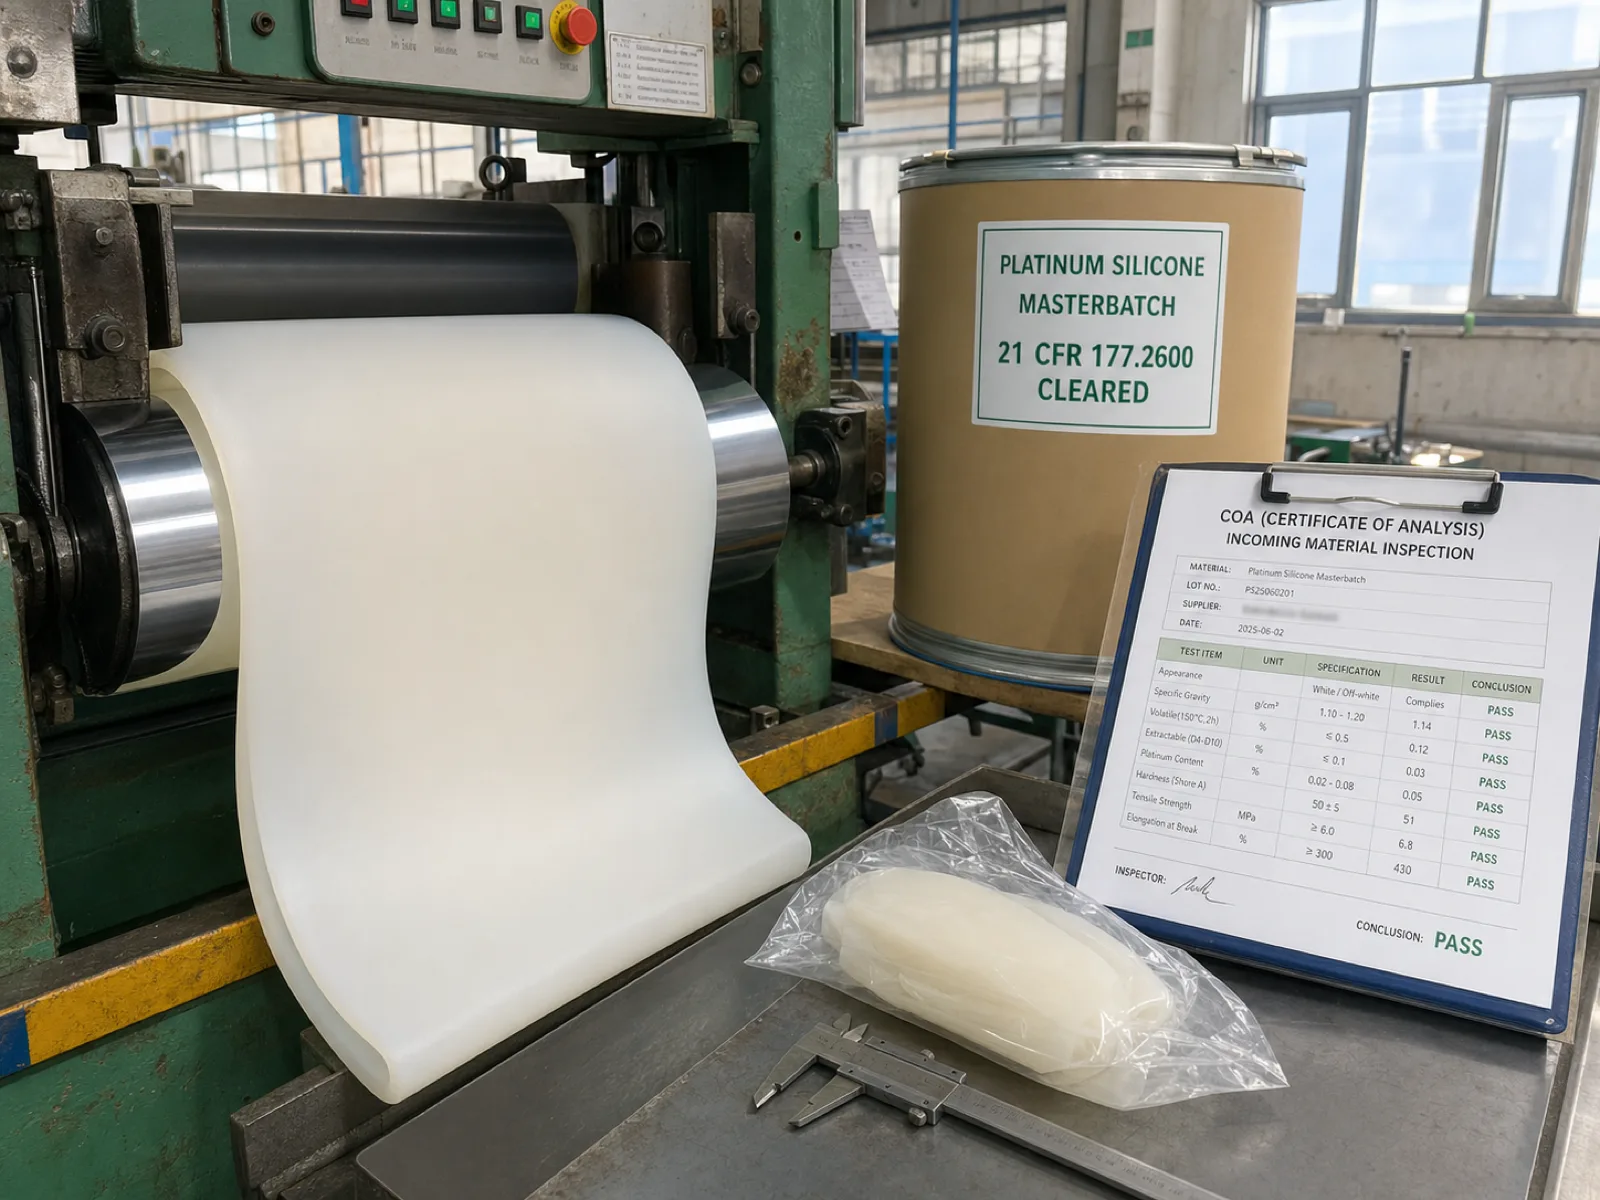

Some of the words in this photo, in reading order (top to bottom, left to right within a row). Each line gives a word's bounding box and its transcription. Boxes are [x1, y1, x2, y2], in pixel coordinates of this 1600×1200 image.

[1000, 254, 1104, 275] PLATINUM
[1112, 255, 1204, 276] SILICONE
[1019, 294, 1175, 316] MASTERBATCH
[999, 341, 1021, 364] 21
[1035, 342, 1082, 366] CFR
[1092, 344, 1193, 368] 177.2600
[1038, 378, 1149, 403] CLEARED
[1220, 509, 1254, 525] COA
[1261, 510, 1368, 532] (CERTIFICATE
[1372, 517, 1394, 532] OF
[1398, 518, 1485, 540] ANALYSIS)
[1226, 532, 1301, 550] INCOMING
[1305, 537, 1377, 555] MATERIAL
[1383, 541, 1474, 561] INSPECTION
[1190, 562, 1231, 574] MATERIAL:
[1248, 567, 1282, 578] Platinum
[1283, 569, 1314, 580] Silicone
[1316, 571, 1366, 584] Masterbatch
[1187, 581, 1202, 592] LOT
[1204, 582, 1221, 593] NO.:
[1183, 599, 1221, 612] SUPPLIER:
[1180, 618, 1202, 629] DATE:
[1238, 624, 1284, 637] 2025-06-02
[1181, 647, 1200, 657] TEST
[1202, 649, 1222, 659] ITEM
[1263, 656, 1284, 666] UNIT
[1159, 667, 1202, 680] Appearance
[1318, 663, 1380, 677] SPECIFICATION
[1412, 674, 1445, 684] RESULT
[1313, 685, 1336, 695] White
[1342, 688, 1379, 701] Off-white
[1472, 680, 1531, 694] CONCLUSION
[1154, 687, 1182, 699] Specific
[1184, 691, 1210, 704] Gravity
[1406, 696, 1444, 709] Complies
[1320, 708, 1337, 719] 1.10
[1347, 712, 1365, 722] 1.20
[1488, 705, 1514, 717] PASS
[1259, 723, 1267, 731] %
[1413, 720, 1431, 730] 1.14
[1146, 728, 1186, 742] Extractable
[1336, 733, 1349, 743] 0.5
[1485, 729, 1511, 741] PASS
[1255, 745, 1263, 753] %
[1409, 744, 1428, 754] 0.12
[1141, 749, 1172, 761] Platinum
[1174, 754, 1204, 767] Content
[1333, 756, 1345, 765] 0.1
[1482, 753, 1508, 765] PASS
[1252, 767, 1259, 776] %
[1406, 767, 1425, 778] 0.03
[1172, 775, 1196, 788] (Shore
[1198, 780, 1206, 790] A)
[1308, 776, 1326, 787] 0.02
[1335, 779, 1354, 790] 0.08
[1479, 777, 1506, 790] PASS
[1402, 790, 1422, 801] 0.05
[1159, 797, 1192, 810] Strength
[1312, 800, 1324, 809] 50
[1333, 803, 1339, 812] 5
[1476, 801, 1503, 814] PASS
[1127, 812, 1165, 828] Elongation
[1167, 821, 1174, 829] at
[1177, 824, 1198, 834] Break
[1238, 811, 1255, 822] MPa
[1403, 815, 1414, 824] 51
[1320, 826, 1335, 836] 6.0
[1473, 826, 1500, 839] PASS
[1239, 834, 1247, 844] %
[1399, 839, 1413, 850] 6.8
[1316, 849, 1333, 860] 300
[1471, 851, 1497, 864] PASS
[1115, 865, 1167, 885] INSPECTOR:
[1394, 863, 1411, 875] 430
[1467, 876, 1494, 890] PASS
[1357, 920, 1423, 944] CONCLUSION:
[1434, 931, 1483, 957] PASS
